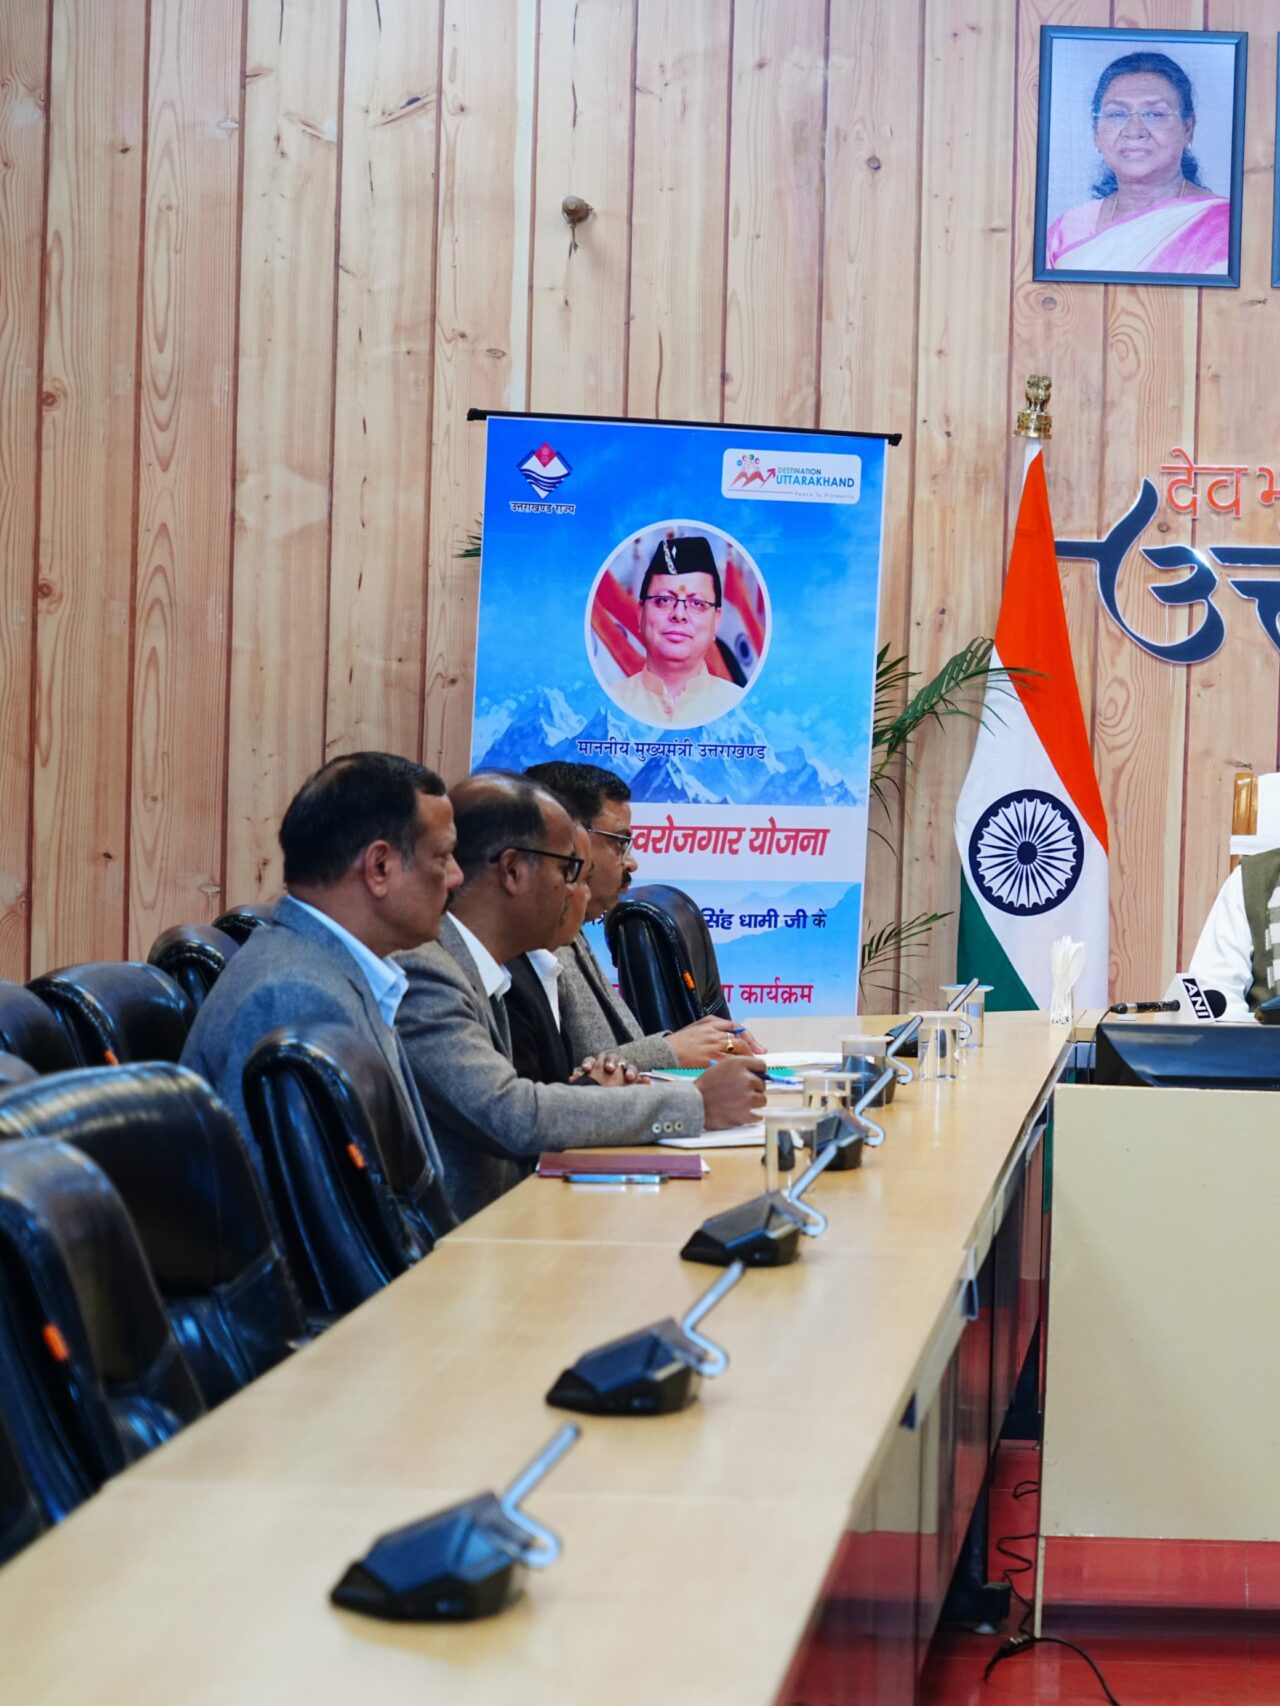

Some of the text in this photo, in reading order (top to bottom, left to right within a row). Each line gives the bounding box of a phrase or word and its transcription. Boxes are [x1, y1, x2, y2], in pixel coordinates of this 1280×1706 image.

[776, 475, 855, 488] UTTARAKHAND
[777, 467, 822, 475] DESTINATION
[1160, 447, 1248, 519] देव
[553, 504, 576, 515] राज्य
[577, 737, 766, 761] माननीय मुख्यमंत्री उत्तराखण्ड
[749, 816, 831, 856] योजना
[701, 907, 827, 930] सिंह धामी जी के
[739, 976, 814, 1004] कार्यक्रम
[1183, 980, 1210, 1017] ANI
